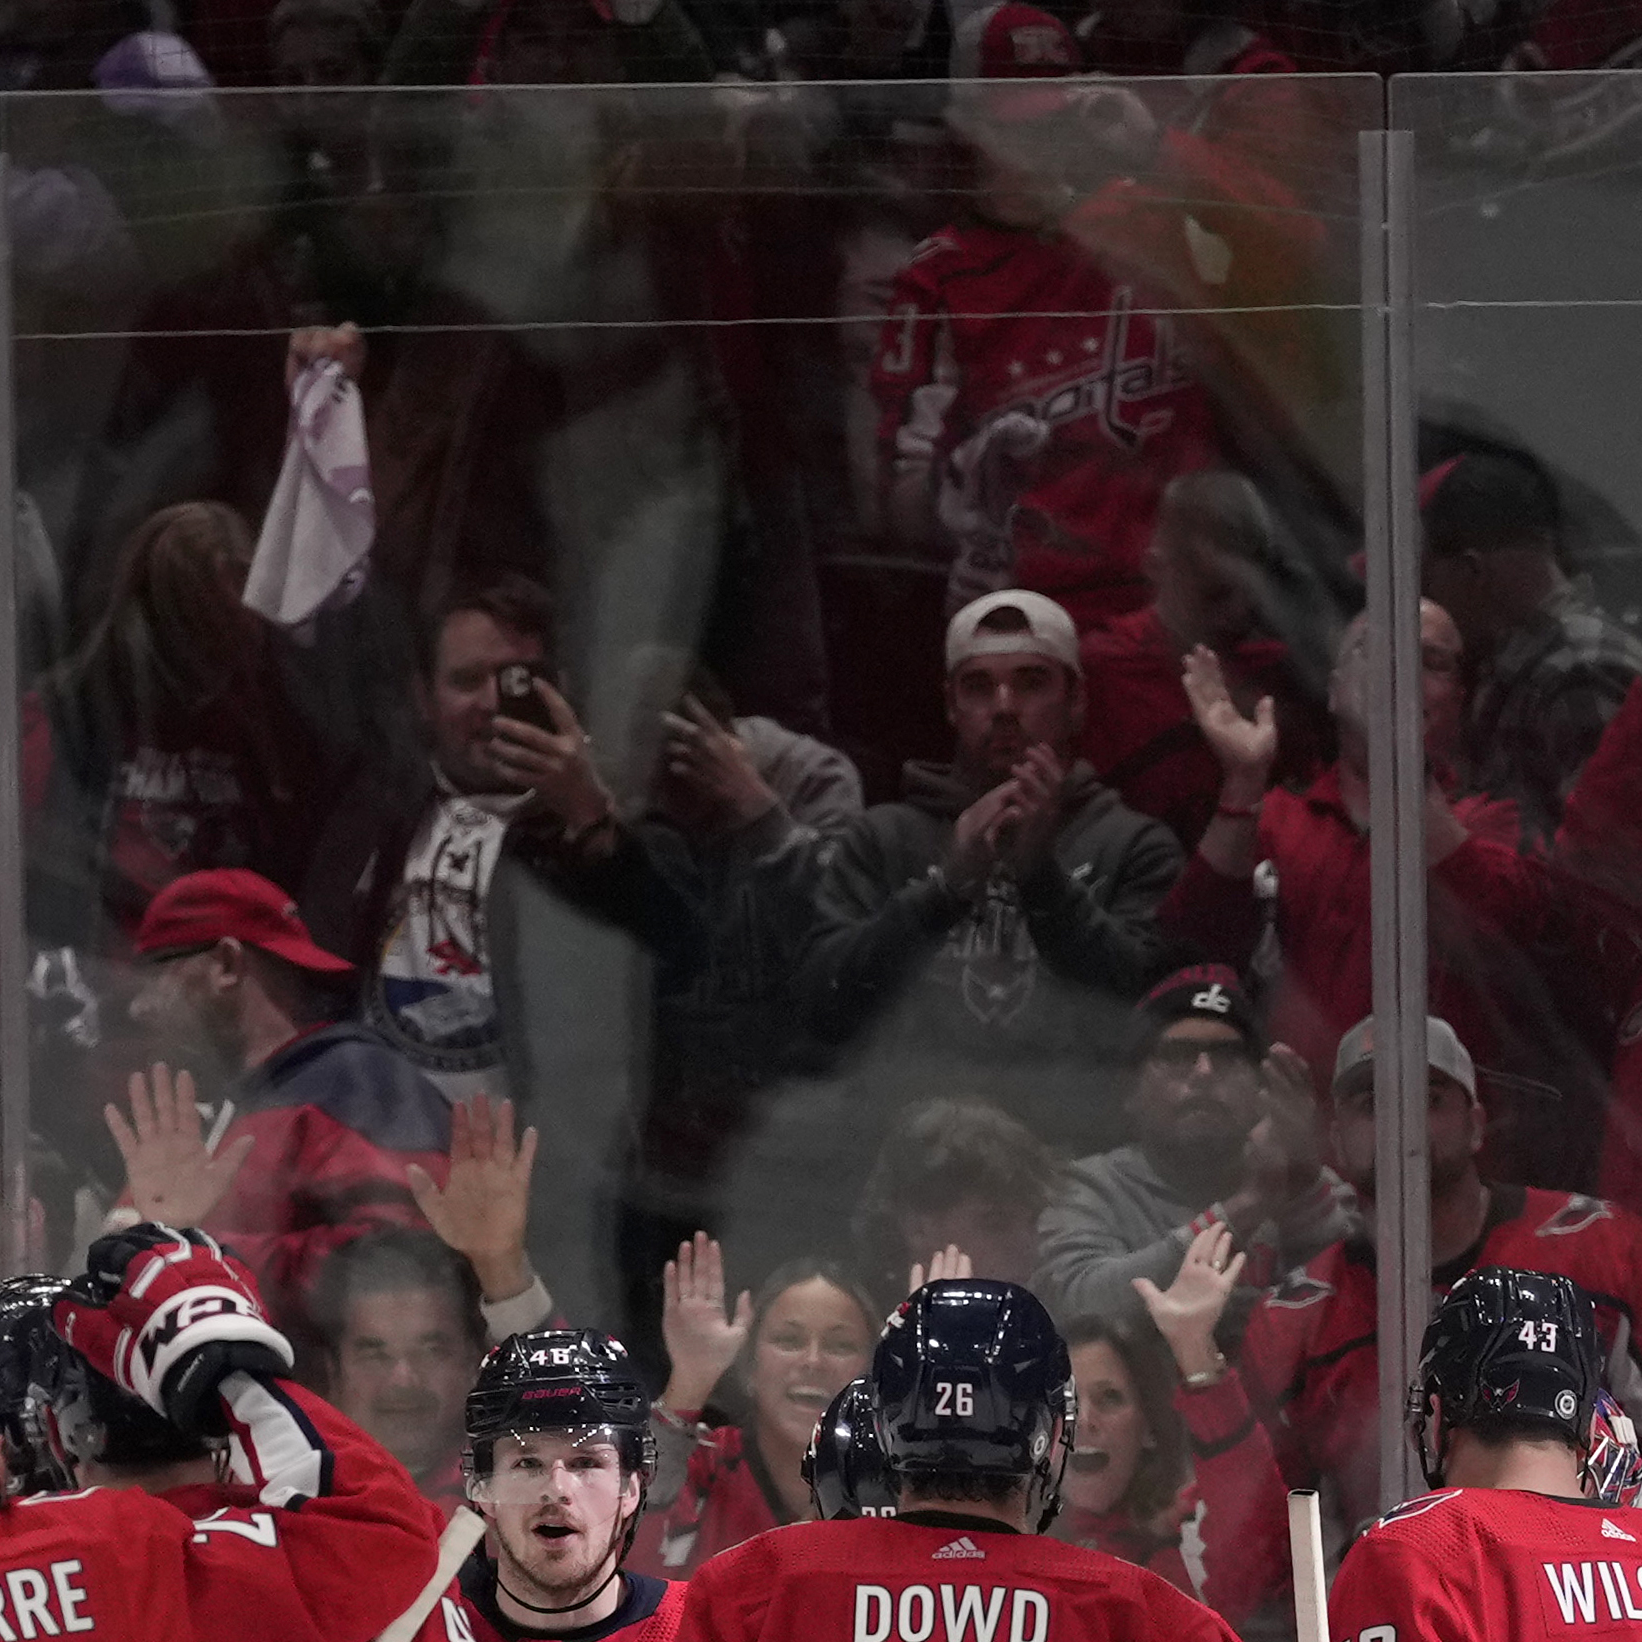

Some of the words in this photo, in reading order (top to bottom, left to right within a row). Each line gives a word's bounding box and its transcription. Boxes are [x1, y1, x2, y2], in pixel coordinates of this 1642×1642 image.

[1518, 1319, 1558, 1353] 43
[528, 1345, 573, 1367] 46
[934, 1381, 975, 1418] 26
